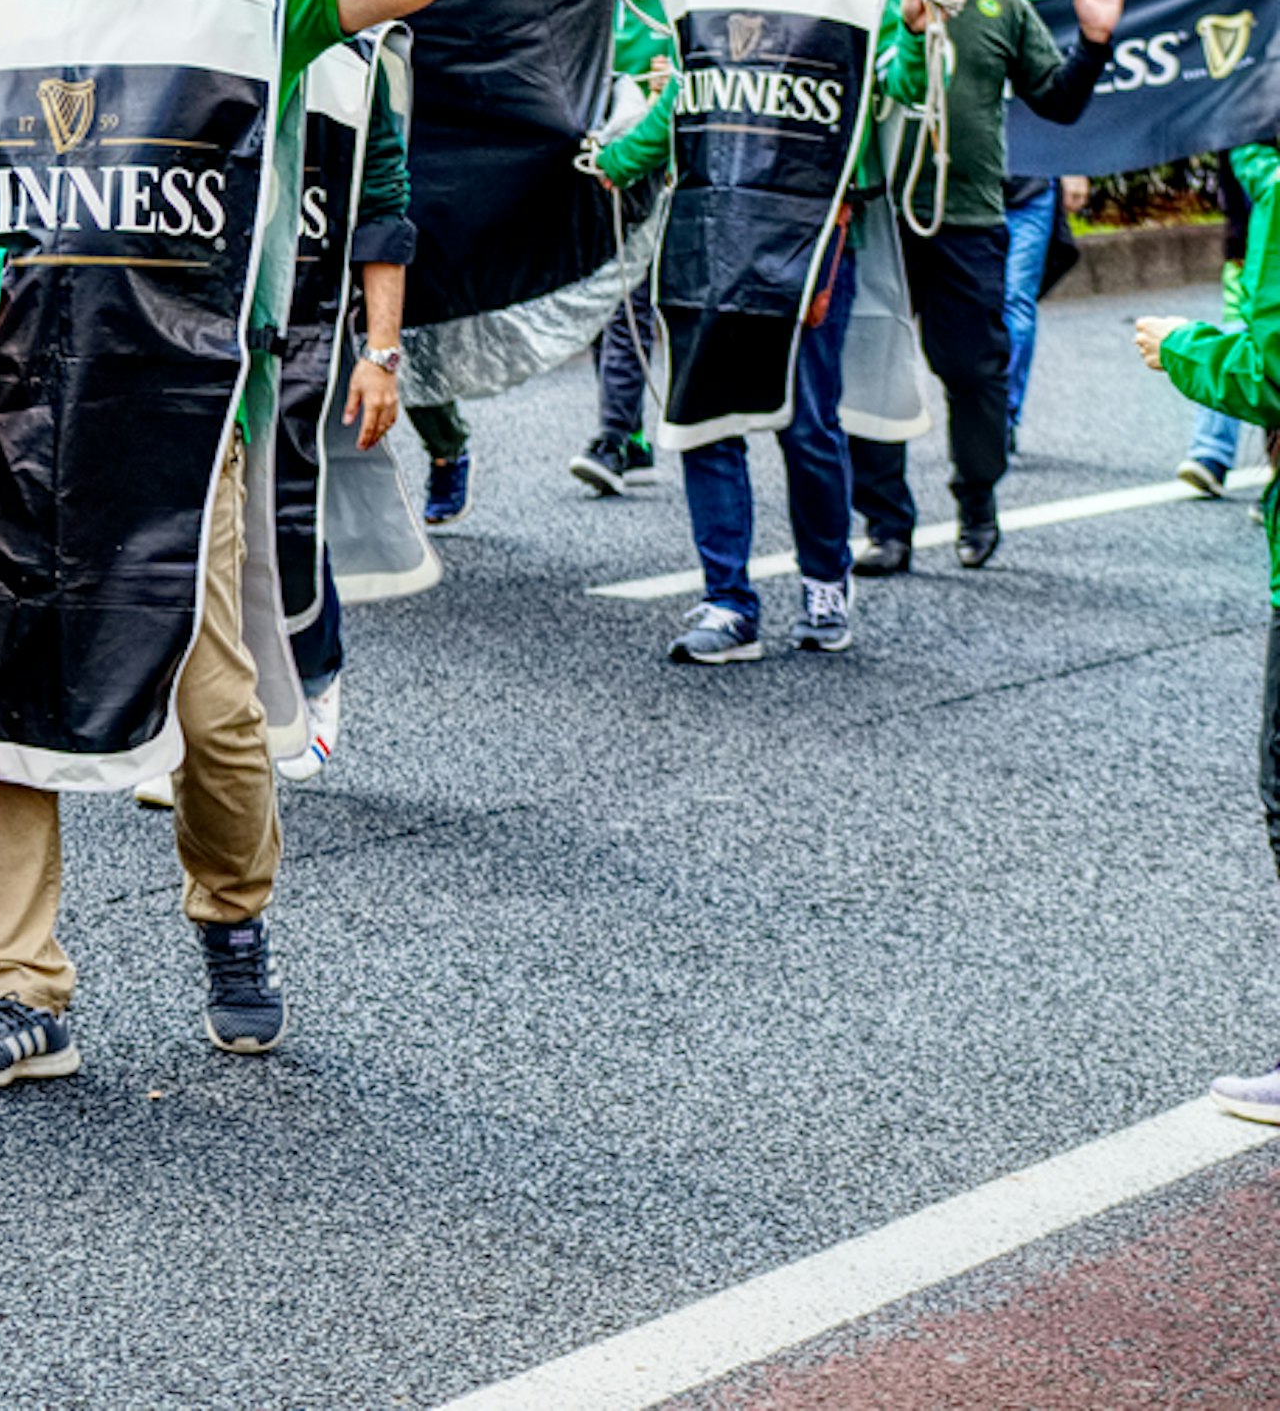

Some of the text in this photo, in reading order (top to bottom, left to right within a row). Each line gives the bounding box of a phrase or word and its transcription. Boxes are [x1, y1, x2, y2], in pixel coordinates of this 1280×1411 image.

[676, 68, 843, 125] UINNESS
[18, 114, 120, 133] 17 59
